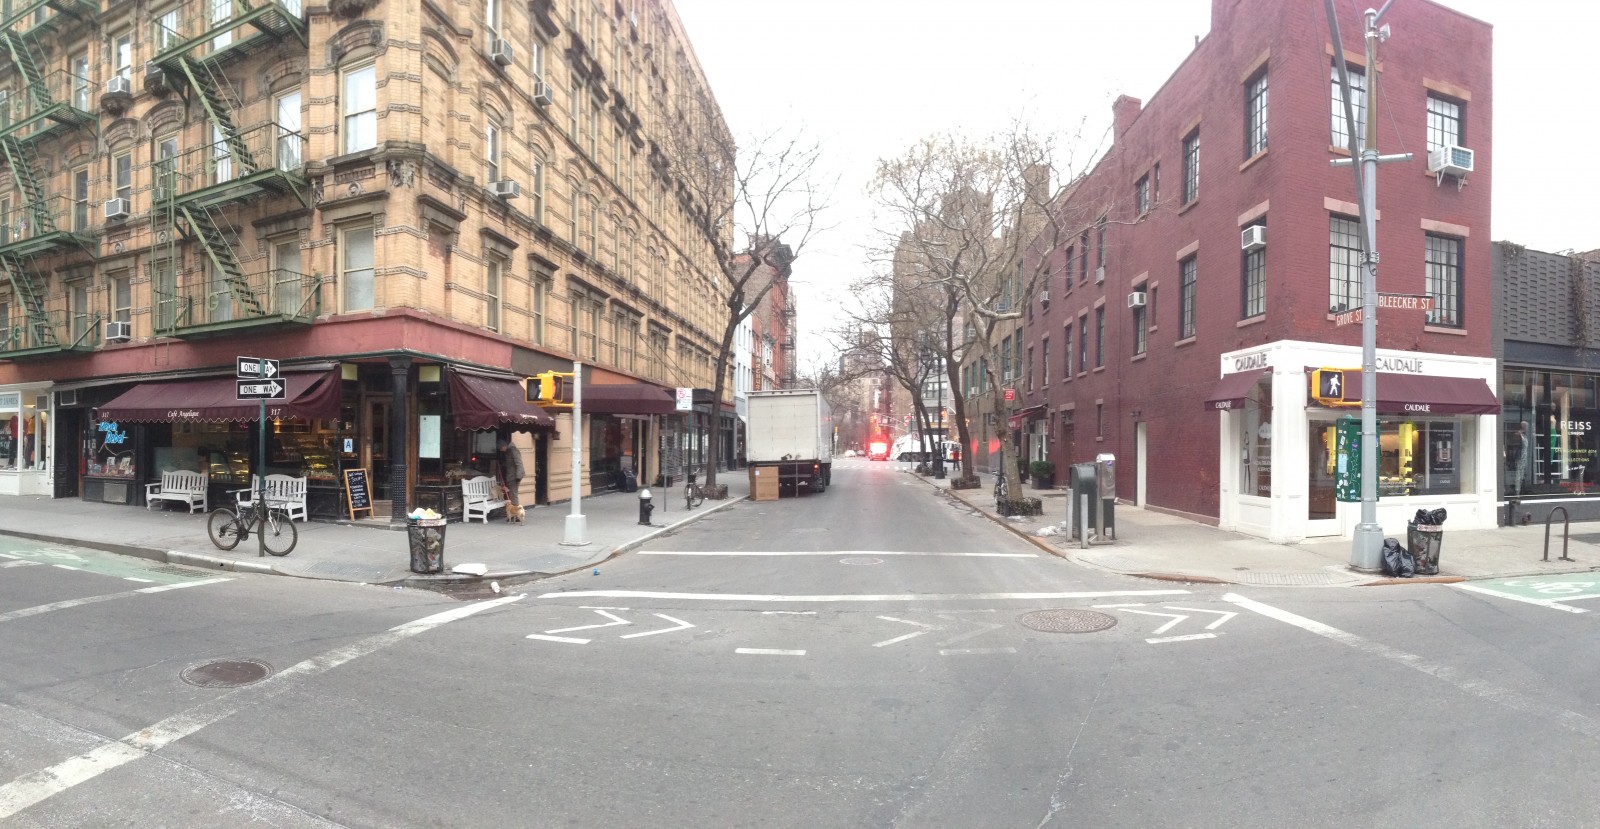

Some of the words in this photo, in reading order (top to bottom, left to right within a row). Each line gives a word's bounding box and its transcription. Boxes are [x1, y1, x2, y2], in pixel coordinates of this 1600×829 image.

[1379, 296, 1417, 309] BLEECKER
[1421, 298, 1430, 310] ST
[1336, 313, 1353, 326] GROVE
[1355, 309, 1362, 322] ST
[244, 363, 256, 372] ONE
[243, 385, 257, 394] ONE
[262, 385, 278, 393] WAY
[270, 408, 281, 416] 317
[1560, 421, 1592, 431] REISS
[345, 440, 351, 448] A
